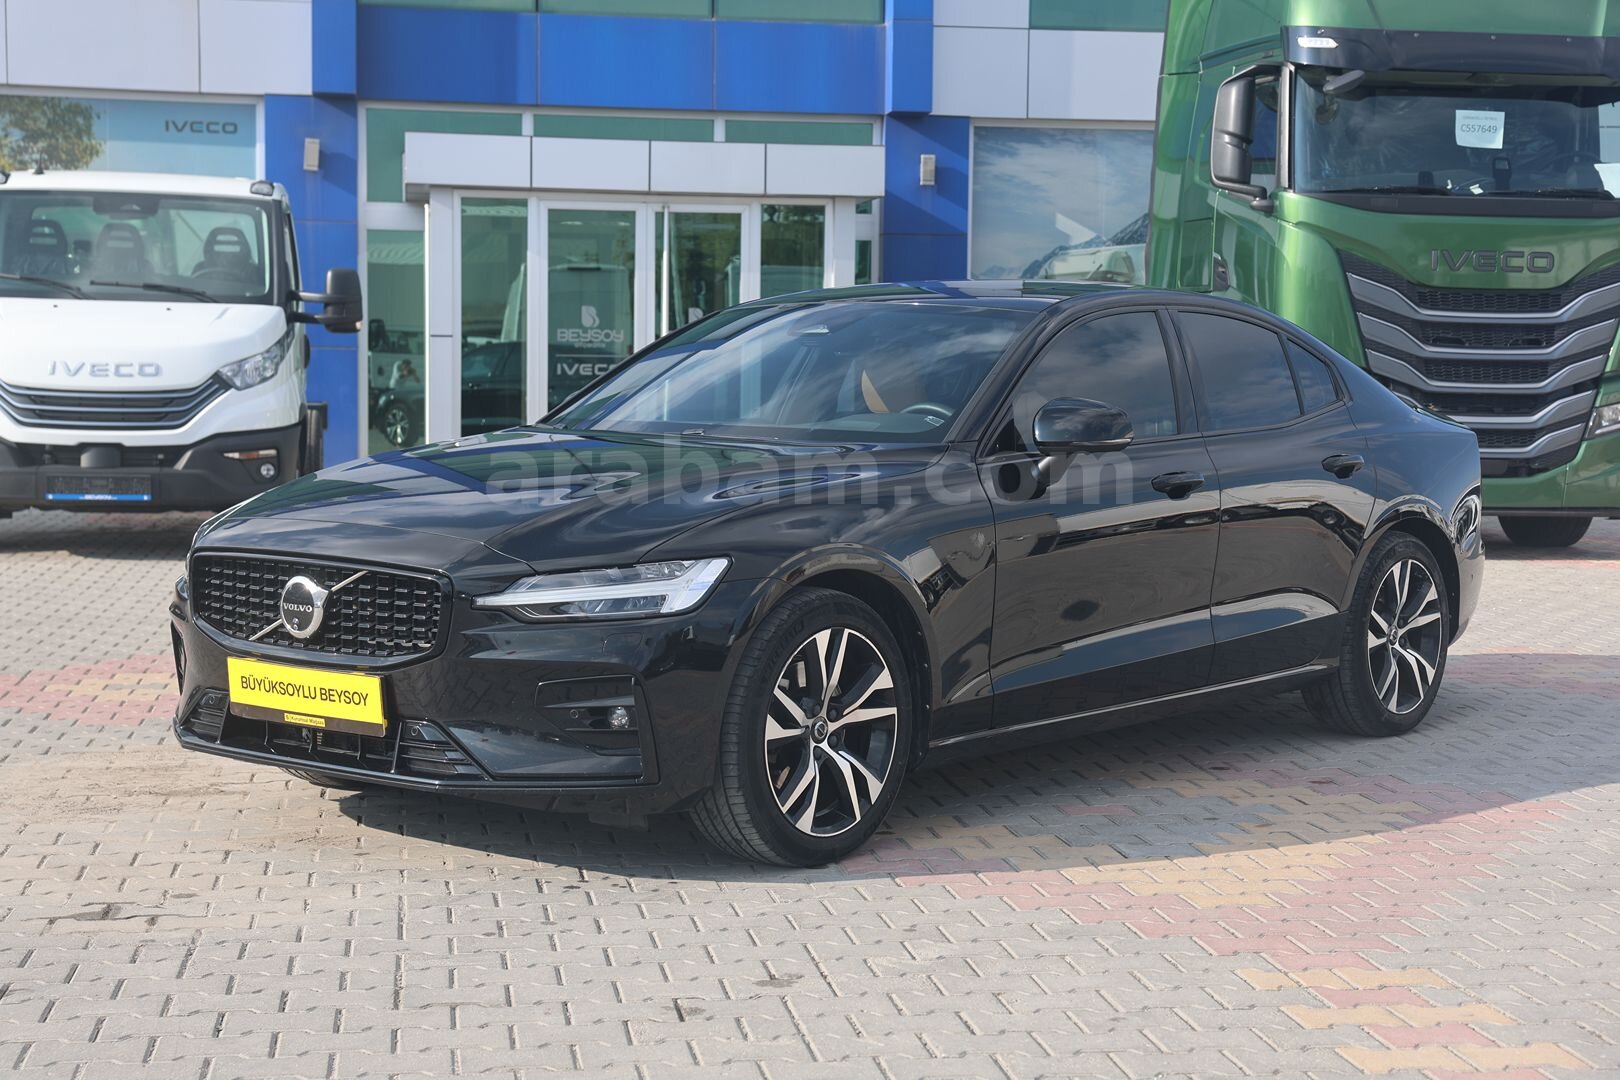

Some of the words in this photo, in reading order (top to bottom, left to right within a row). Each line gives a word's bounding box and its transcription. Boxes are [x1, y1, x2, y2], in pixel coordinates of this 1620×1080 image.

[165, 119, 238, 134] IVECO
[1460, 123, 1497, 133] C557649
[1430, 249, 1555, 273] IVECO
[557, 328, 624, 342] BEYSOY
[48, 360, 162, 377] IVECO
[283, 602, 313, 613] VOLVO
[240, 674, 317, 699] BÜYÜKSOYLU
[319, 687, 369, 706] BEYSOY
